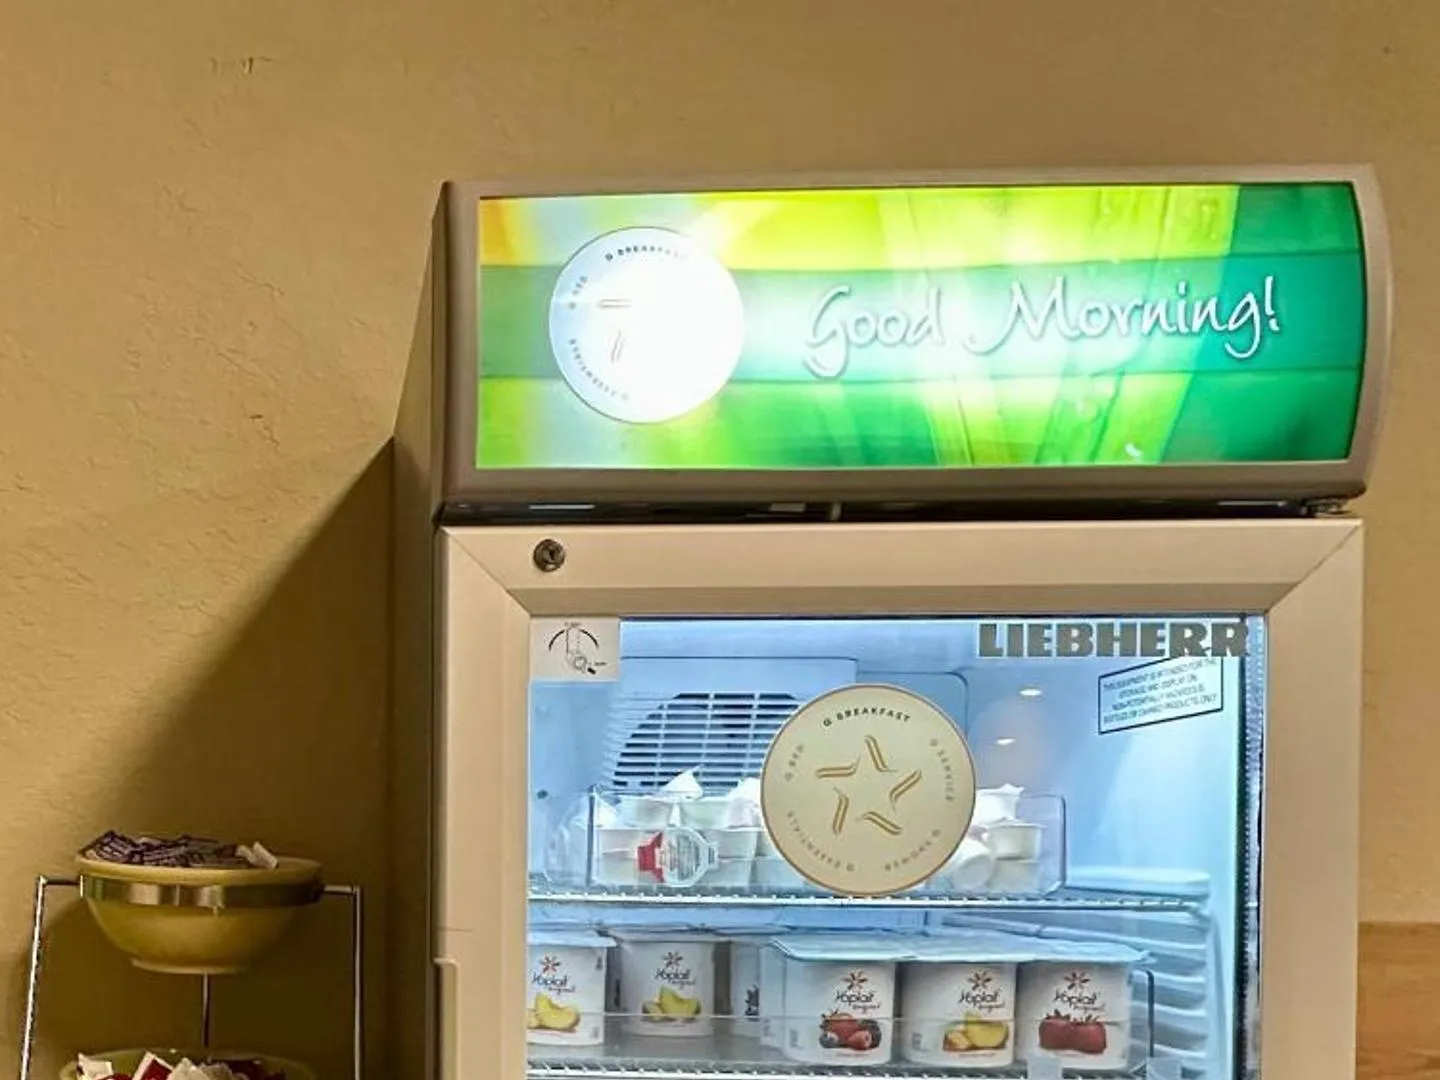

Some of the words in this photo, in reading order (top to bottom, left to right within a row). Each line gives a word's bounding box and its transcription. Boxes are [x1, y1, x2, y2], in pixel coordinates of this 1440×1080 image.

[802, 284, 947, 381] Good
[961, 274, 1281, 360] Morning!
[978, 622, 1249, 657] LIEBHERR
[836, 706, 911, 723] BREAKFAST
